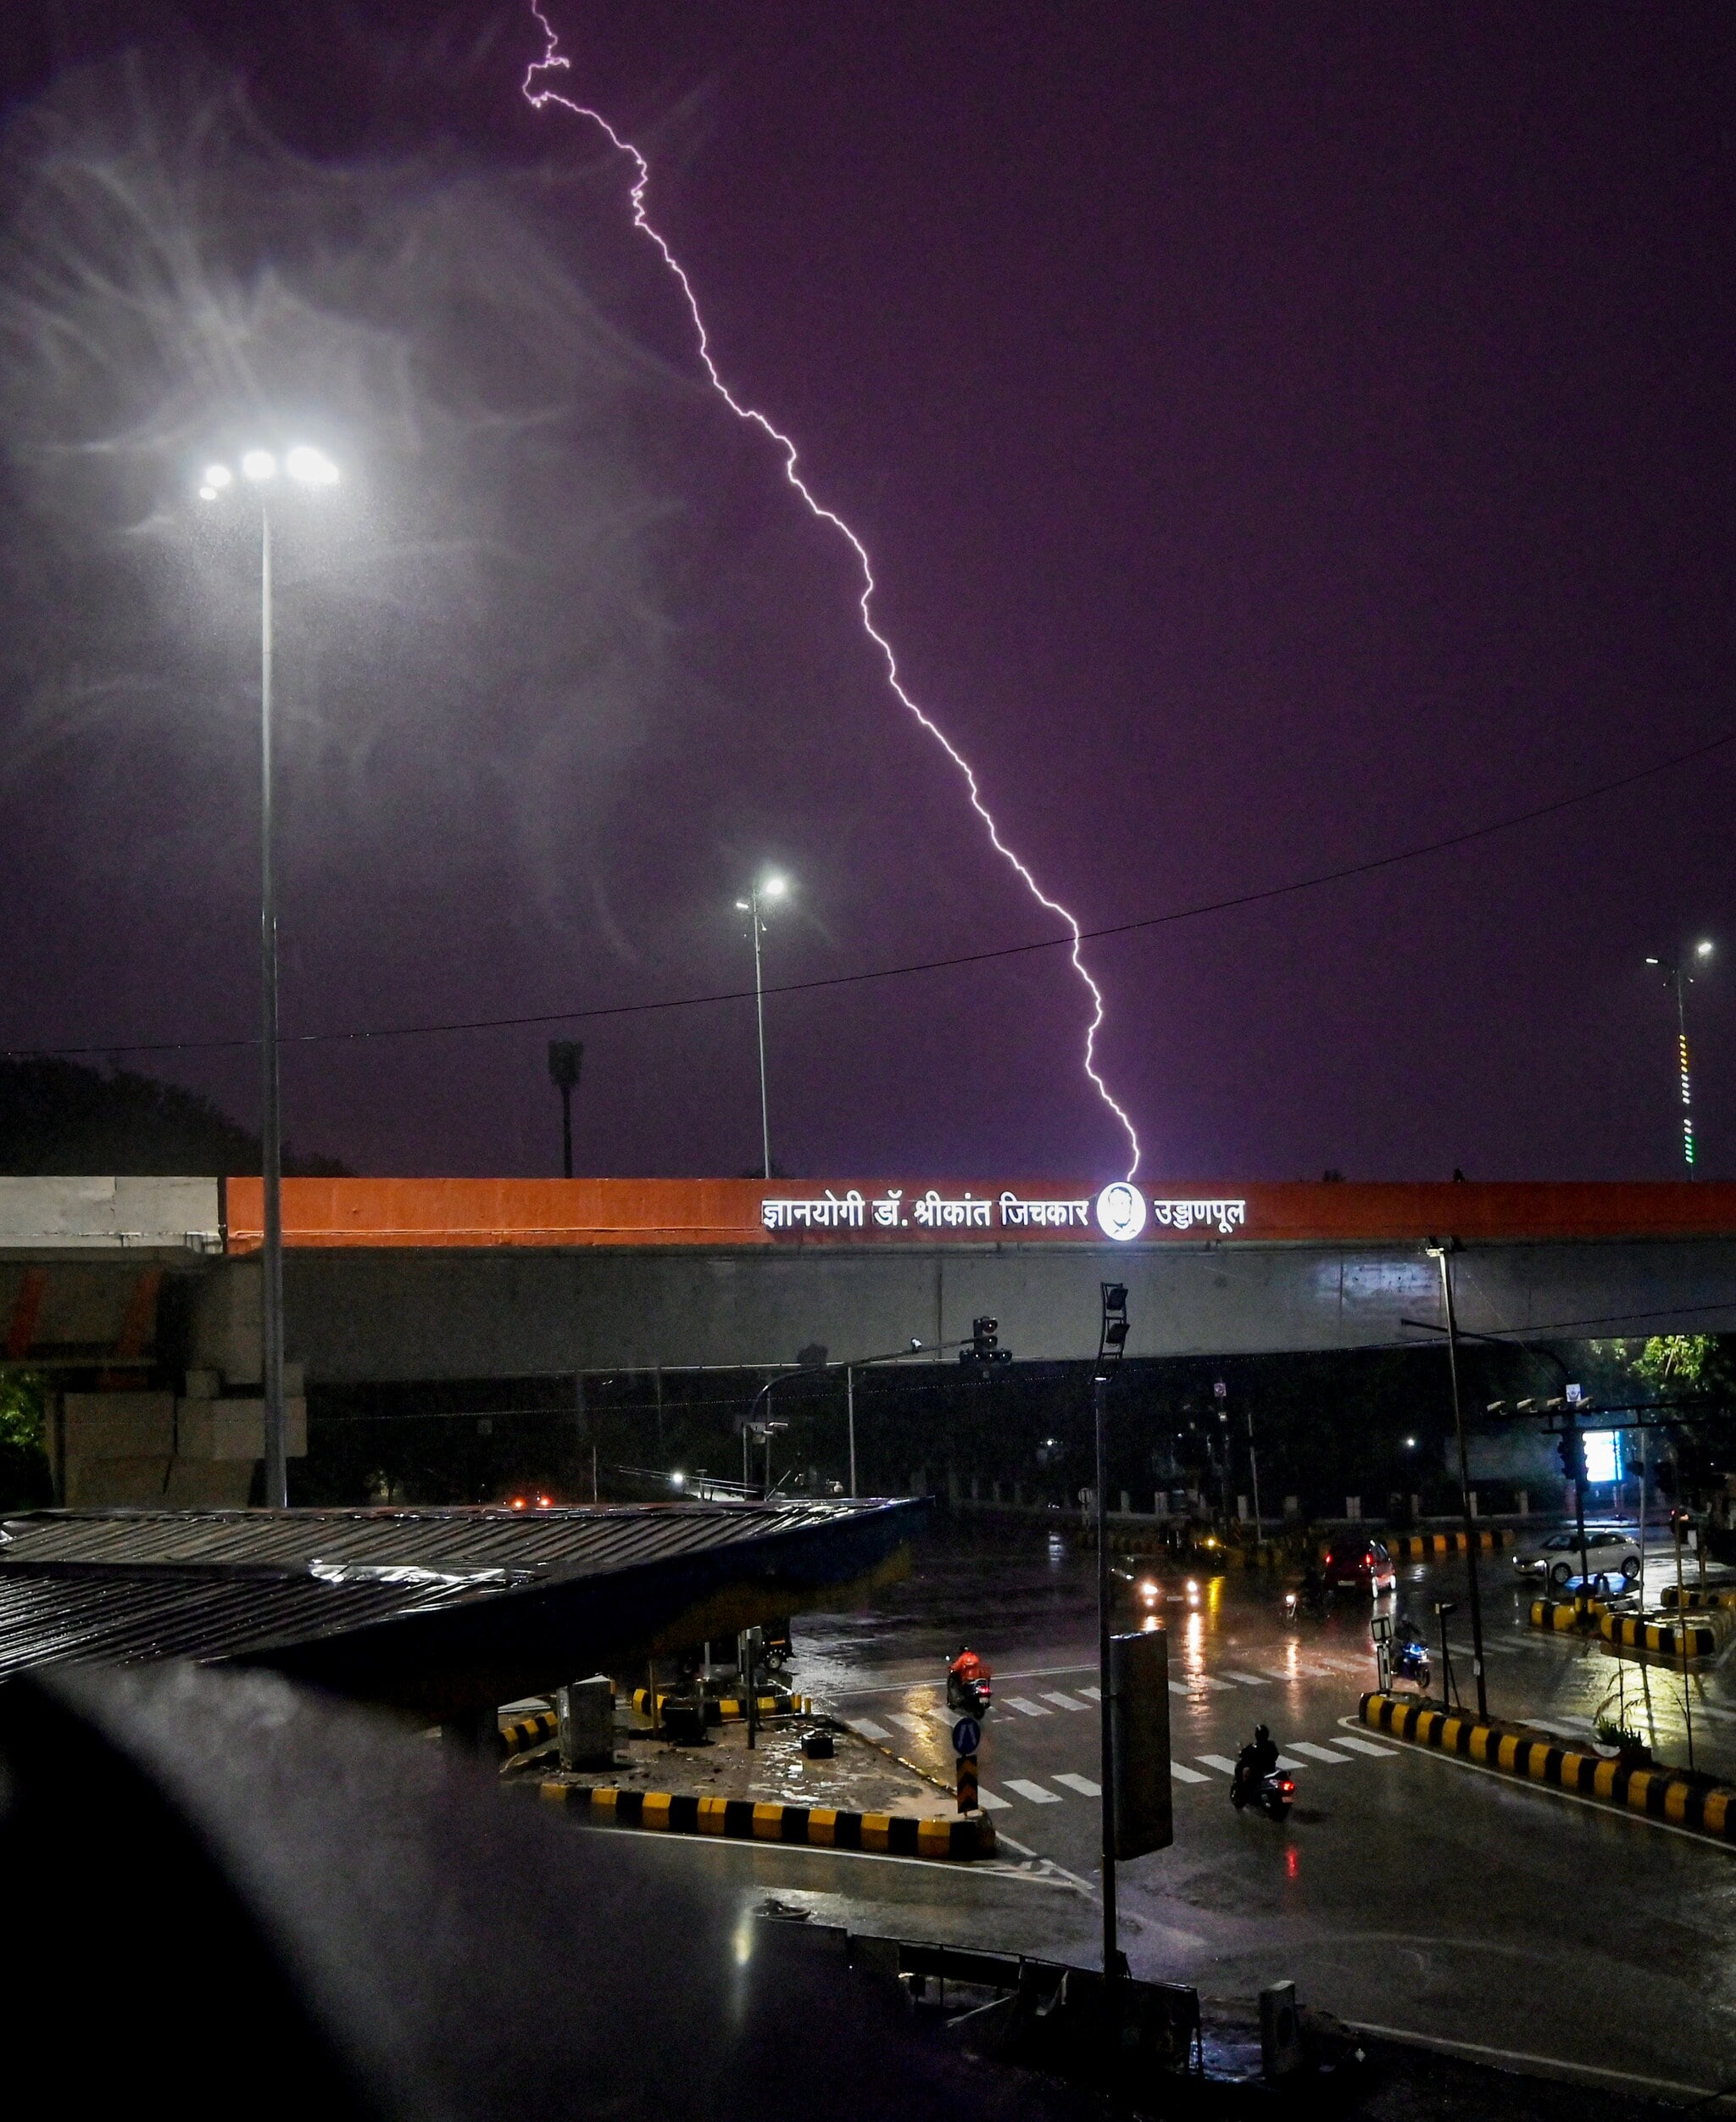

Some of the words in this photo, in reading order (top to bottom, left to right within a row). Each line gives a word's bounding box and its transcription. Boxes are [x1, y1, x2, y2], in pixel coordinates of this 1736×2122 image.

[761, 1189, 865, 1228] ज्ञानयोगी
[872, 1189, 909, 1226] डॉ.
[914, 1190, 992, 1226] श्रीकांत
[999, 1191, 1089, 1226] जिचकार
[1153, 1200, 1246, 1233] उड्डाणपूल
